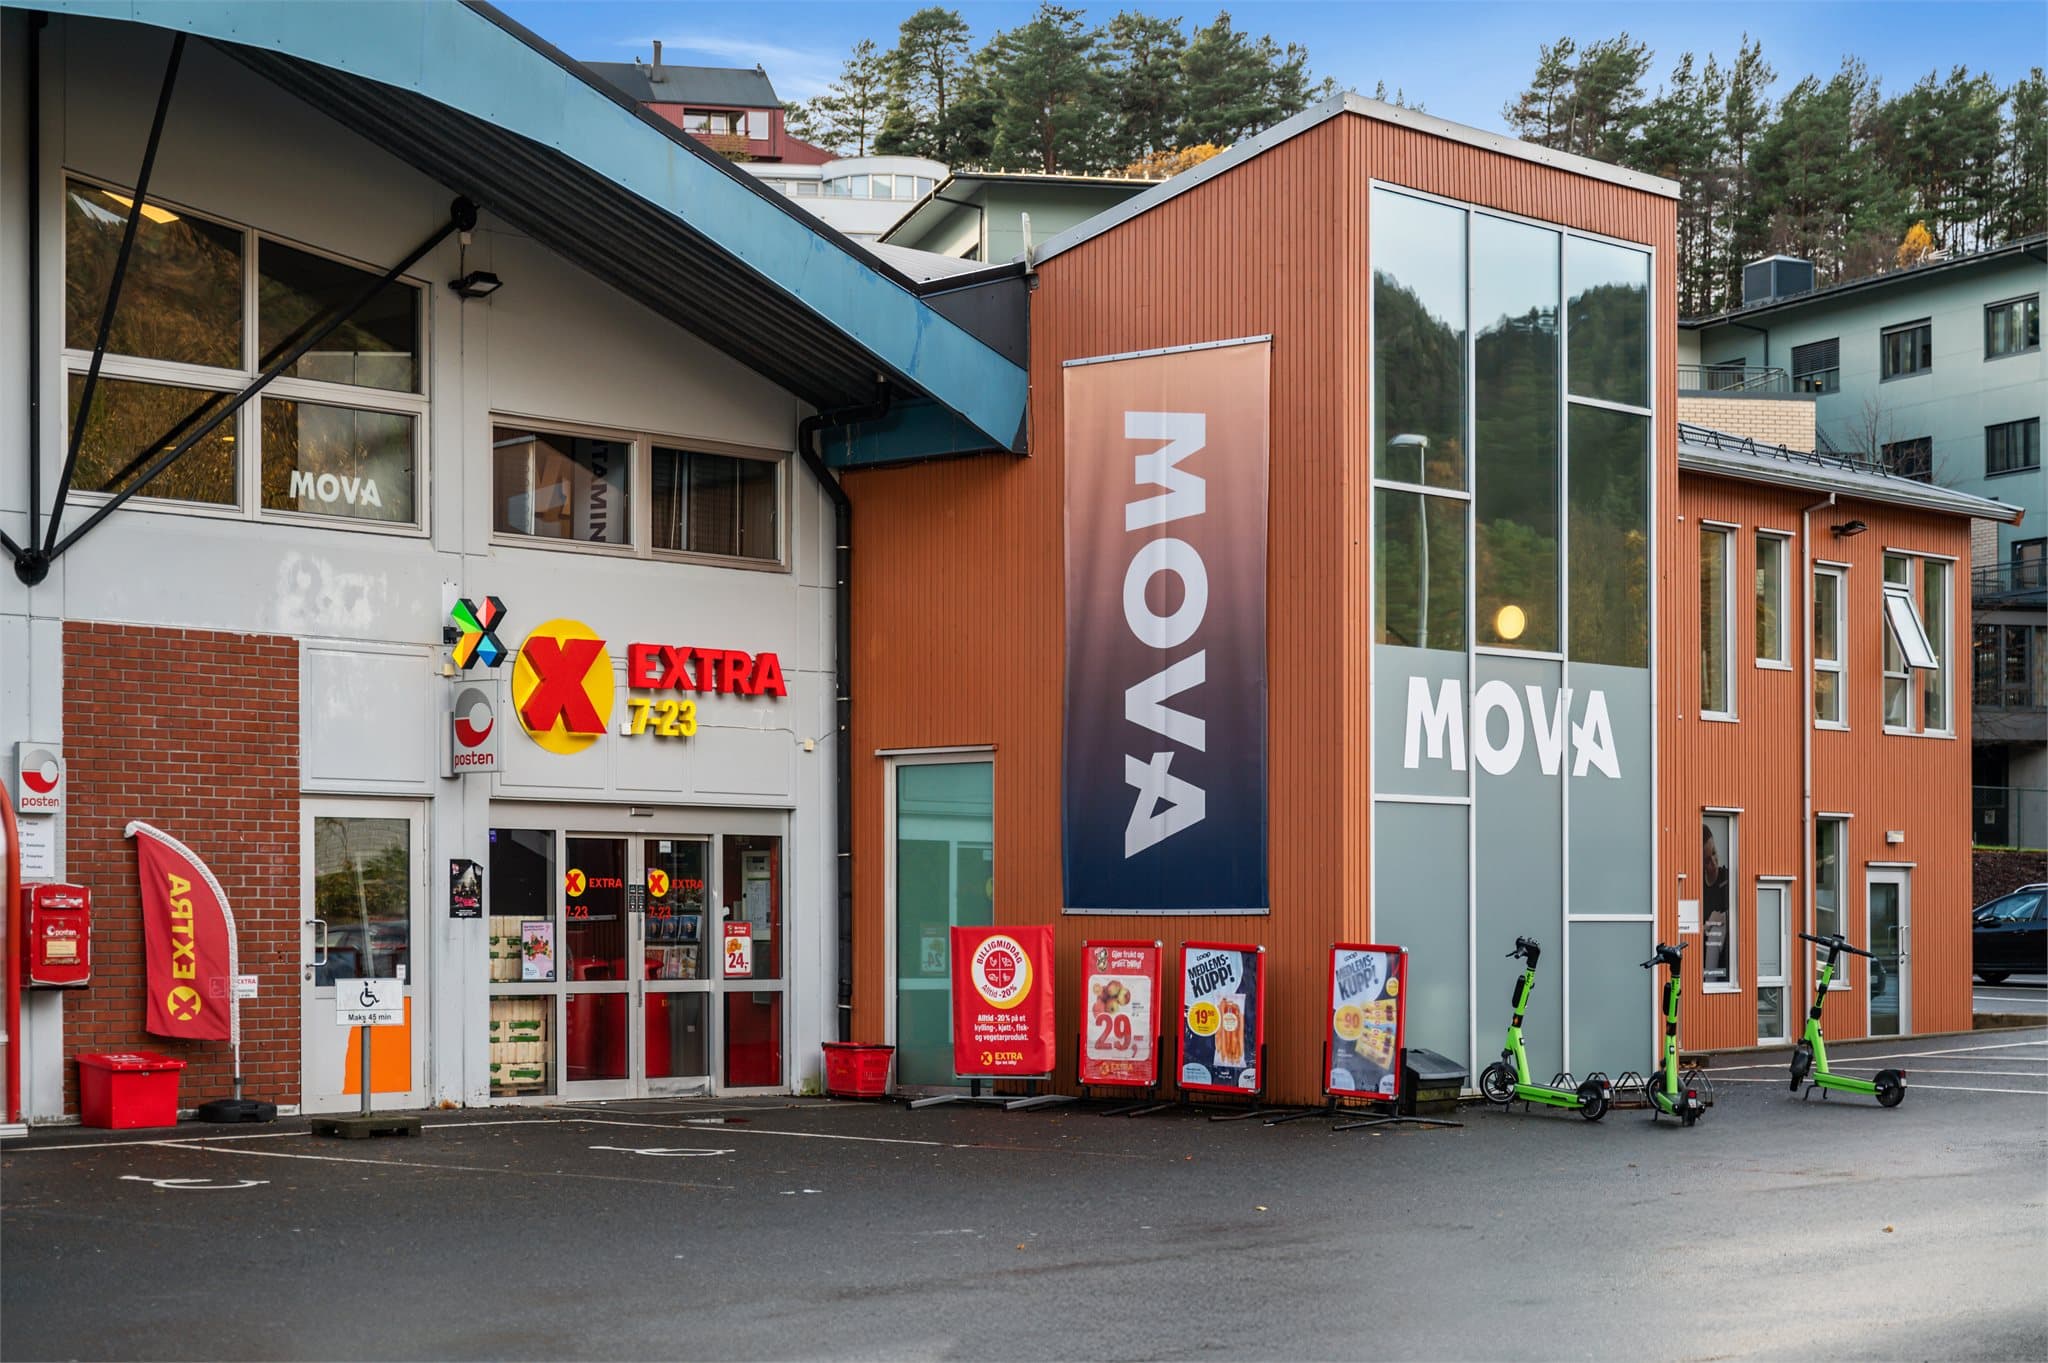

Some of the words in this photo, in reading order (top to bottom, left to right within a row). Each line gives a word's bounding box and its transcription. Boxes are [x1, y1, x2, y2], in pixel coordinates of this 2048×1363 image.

[289, 470, 383, 508] MOVA
[1122, 411, 1208, 859] MOVA
[627, 642, 787, 697] EXTRA
[628, 698, 697, 737] 7-23
[1404, 676, 1621, 779] MOVA
[454, 750, 494, 766] posten
[21, 796, 60, 809] posten
[589, 878, 623, 888] EXTRA
[671, 880, 704, 889] EXTRA
[648, 906, 671, 919] 7-23
[976, 940, 1023, 965] BILLIGMIDDAG
[1188, 953, 1229, 980] MEDLEMS-
[1335, 954, 1374, 980] MEDLEMS-
[1190, 963, 1236, 999] KUPP!
[1338, 964, 1379, 1001] KUPP!
[999, 984, 1018, 999] -20%
[348, 1013, 367, 1021] Maks
[368, 1013, 377, 1021] 45
[379, 1013, 392, 1021] min
[978, 1014, 994, 1022] Alltid
[1011, 1014, 1018, 1023] på
[975, 1034, 983, 1042] og
[994, 1052, 1024, 1061] EXTRA
